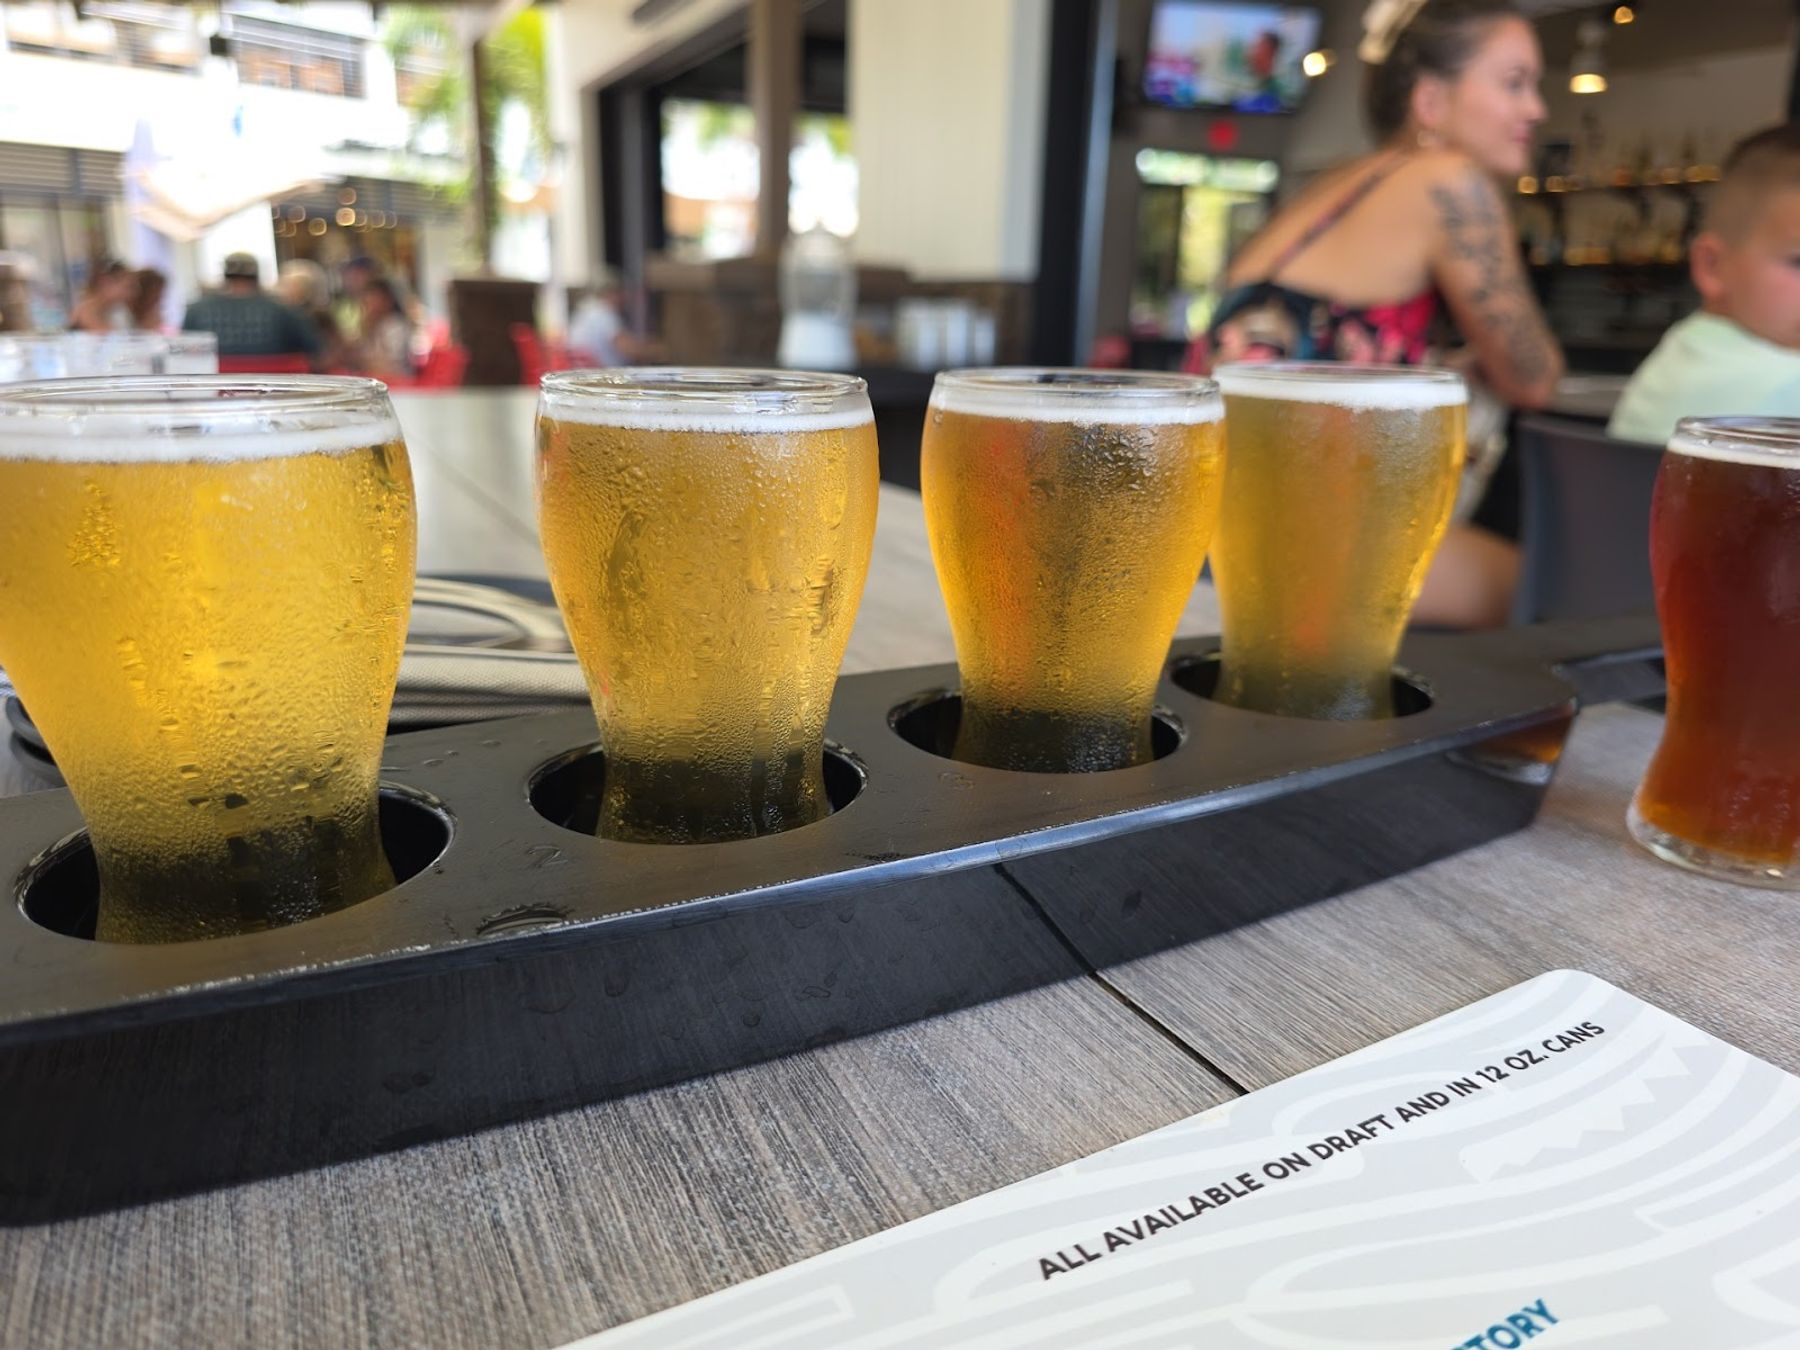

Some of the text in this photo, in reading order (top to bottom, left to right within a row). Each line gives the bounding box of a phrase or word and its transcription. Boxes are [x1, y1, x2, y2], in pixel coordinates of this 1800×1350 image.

[1039, 1021, 1604, 1280] ALL AVAILABLE ON DRAFT AND IN 12 OZ. CANS
